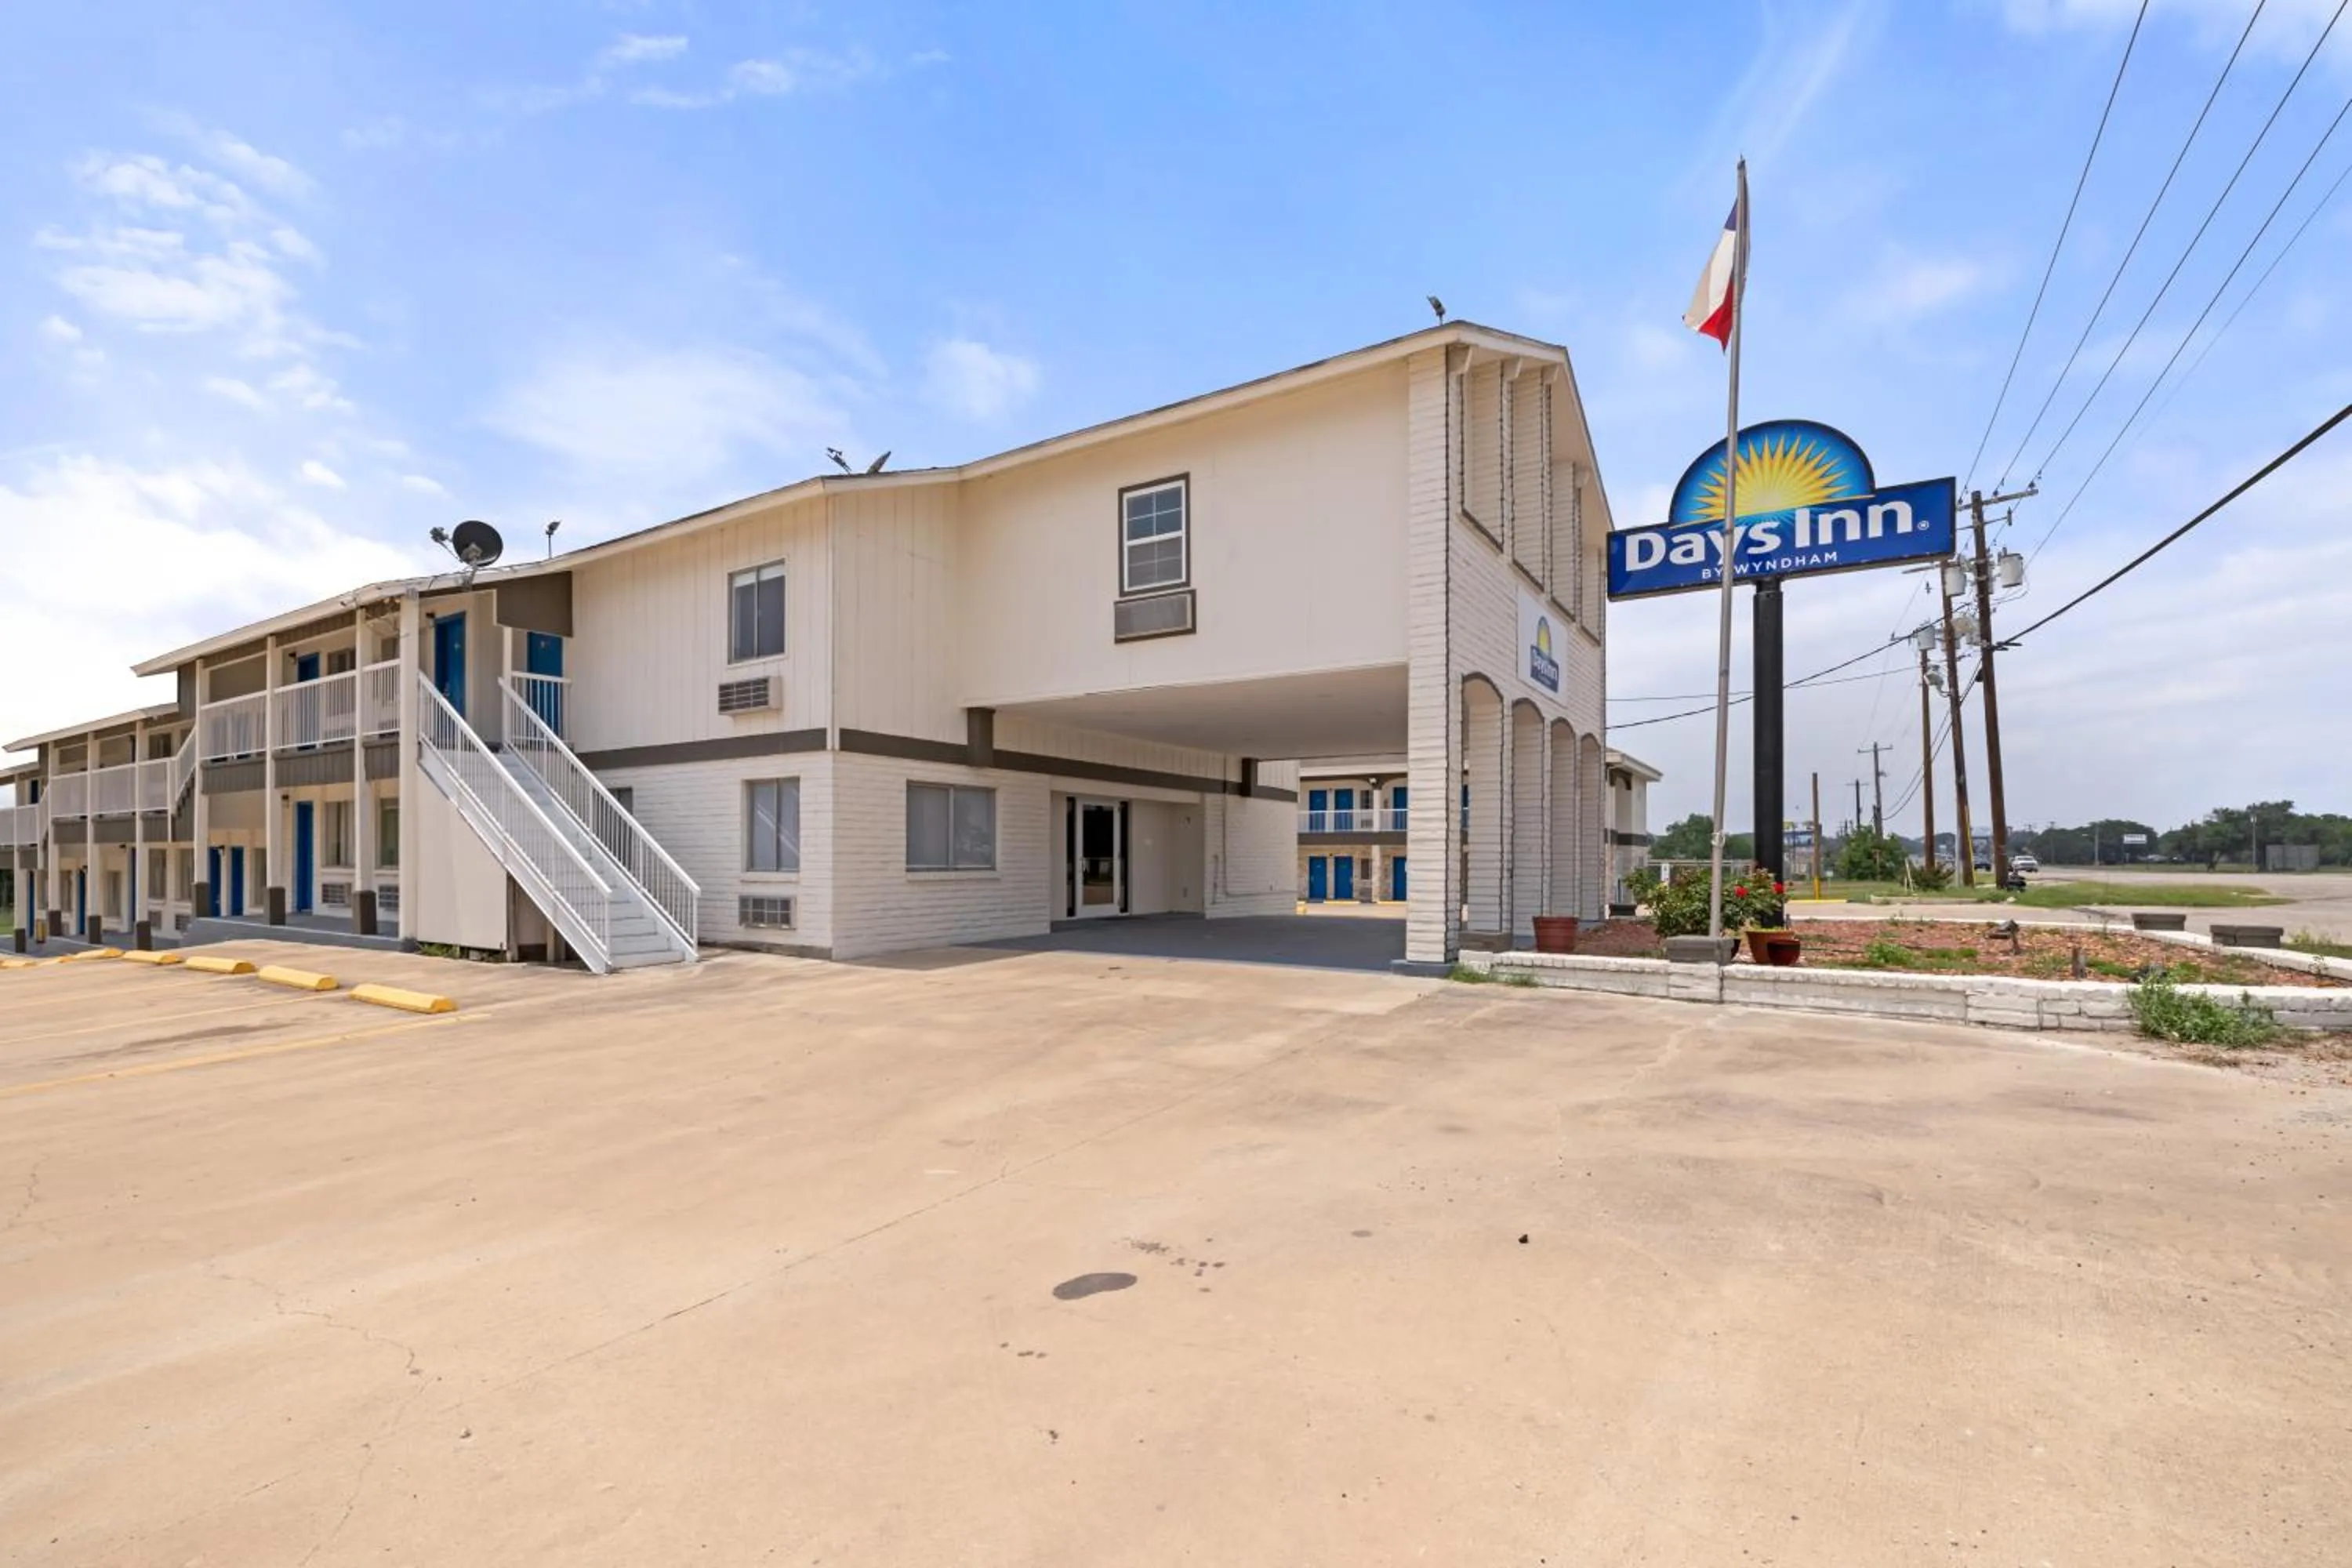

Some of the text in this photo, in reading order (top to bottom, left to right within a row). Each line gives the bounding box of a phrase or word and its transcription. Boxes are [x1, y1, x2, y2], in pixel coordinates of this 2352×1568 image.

[1625, 501, 1913, 572] Days Inn
[1702, 551, 1838, 579] BY WYNDHAM
